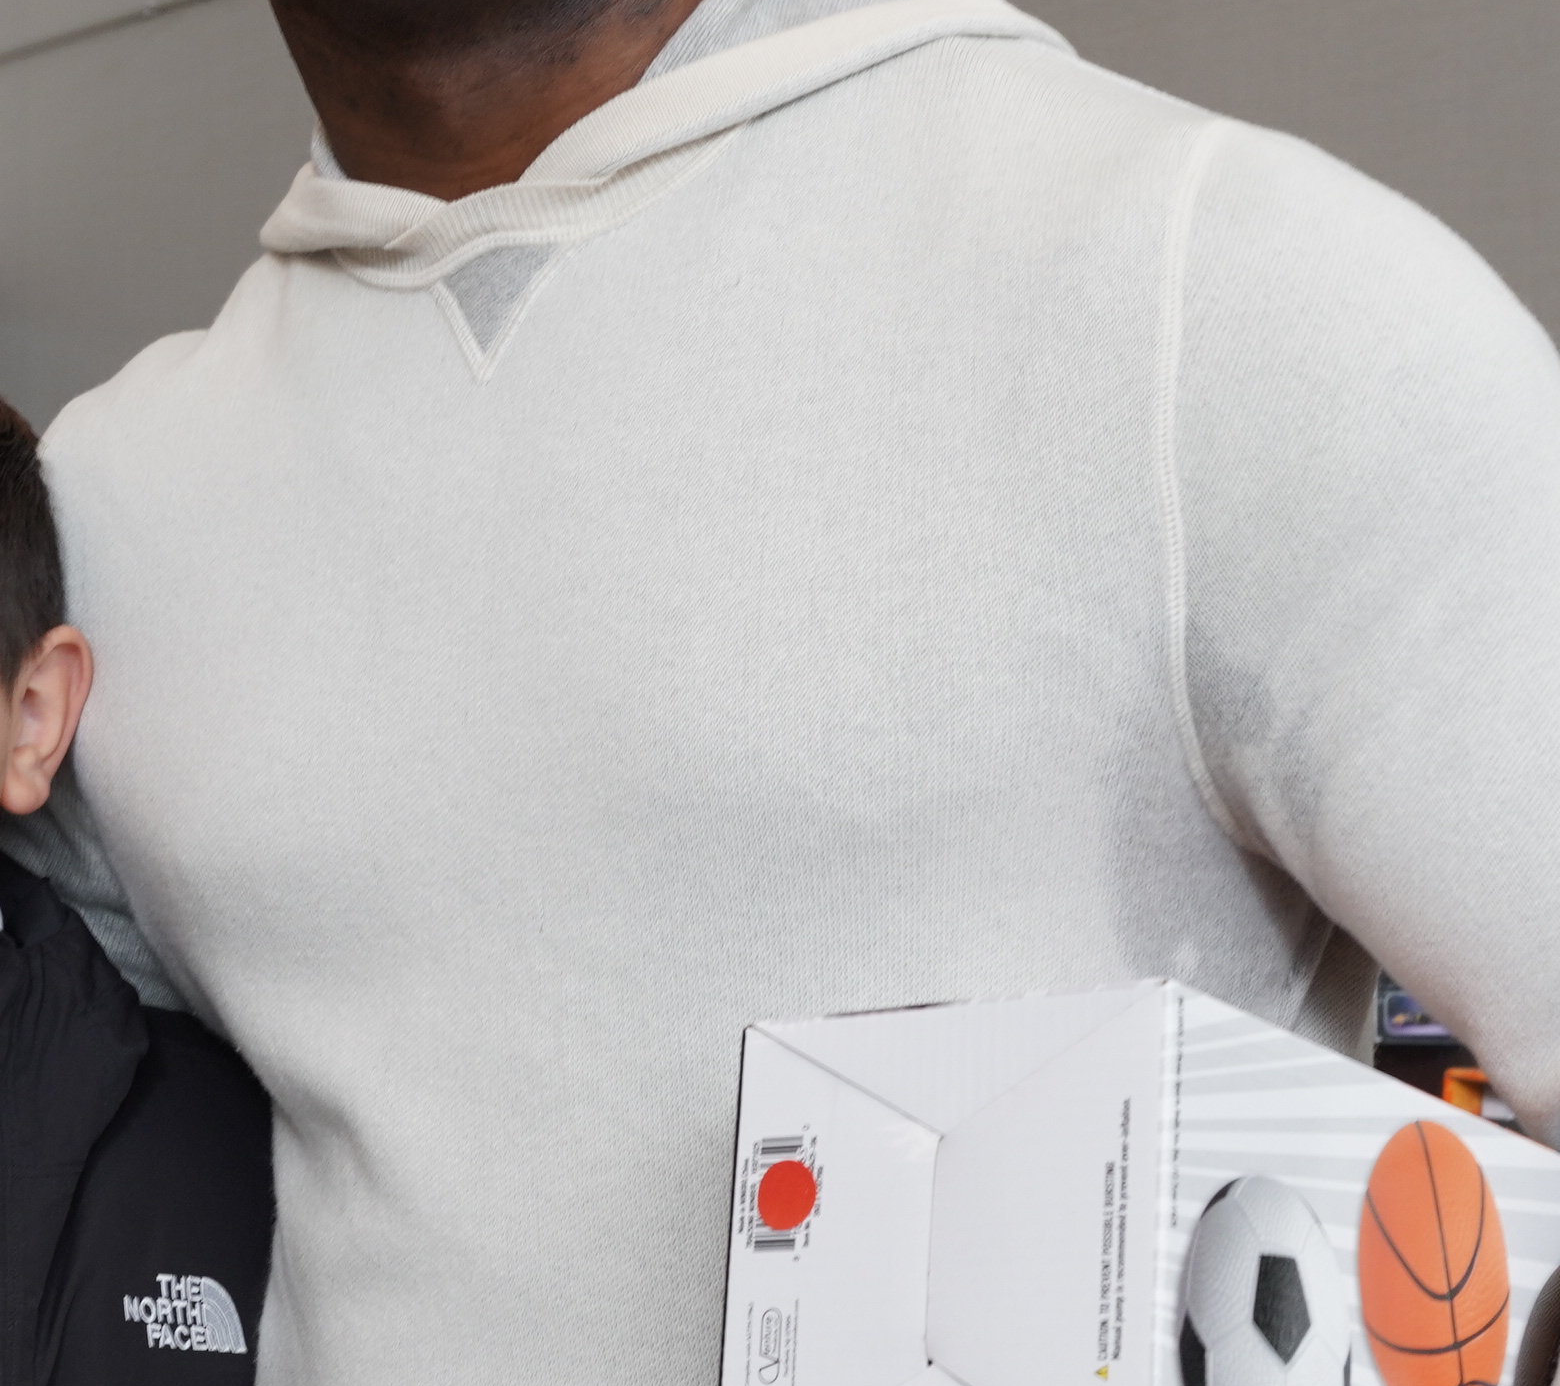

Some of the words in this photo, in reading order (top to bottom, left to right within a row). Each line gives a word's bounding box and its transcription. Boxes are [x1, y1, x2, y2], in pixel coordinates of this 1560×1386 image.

[156, 1273, 202, 1301] THE
[123, 1294, 203, 1325] NORTH
[147, 1323, 208, 1351] FACE
